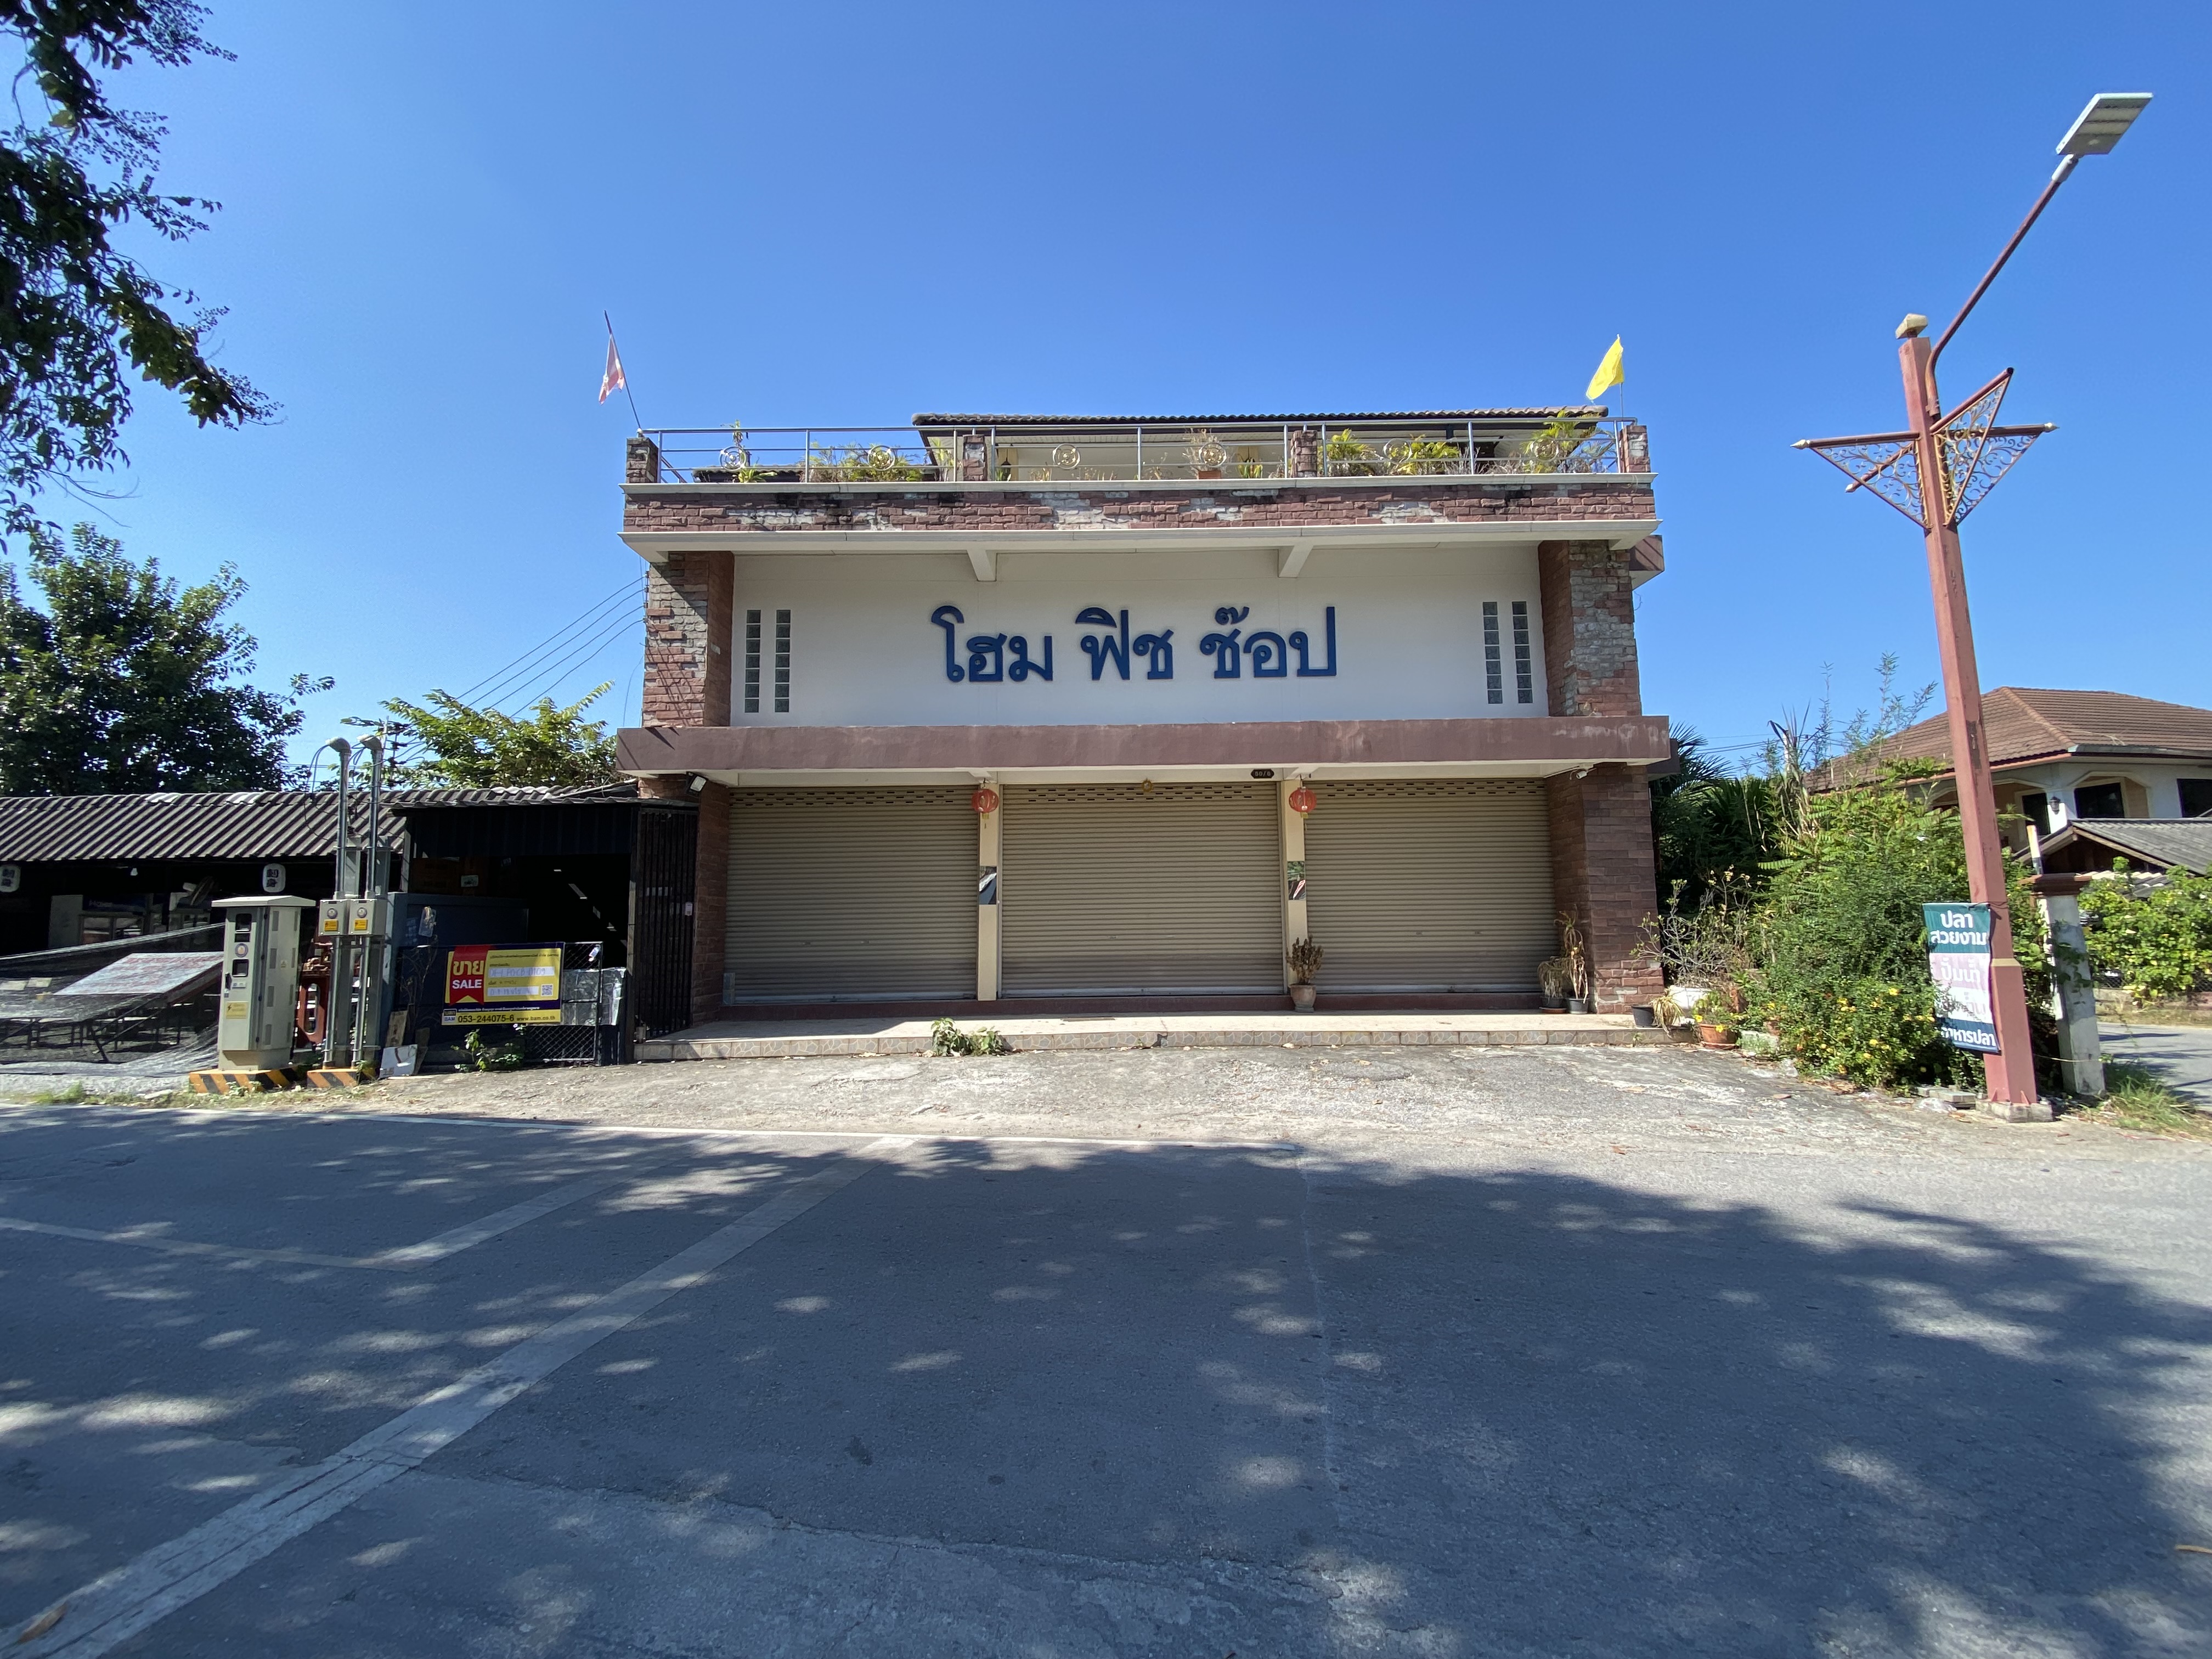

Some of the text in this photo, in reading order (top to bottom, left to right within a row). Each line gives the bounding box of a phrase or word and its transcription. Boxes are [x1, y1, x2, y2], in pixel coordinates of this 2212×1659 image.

[930, 605, 1338, 683] โฮม ฟิช ช๊อป
[1940, 910, 1973, 928] ปลา
[1930, 929, 1987, 945] สวยงาม
[453, 960, 484, 975] ขาย
[452, 979, 482, 989] SALE
[458, 1014, 515, 1023] 053-244075-6
